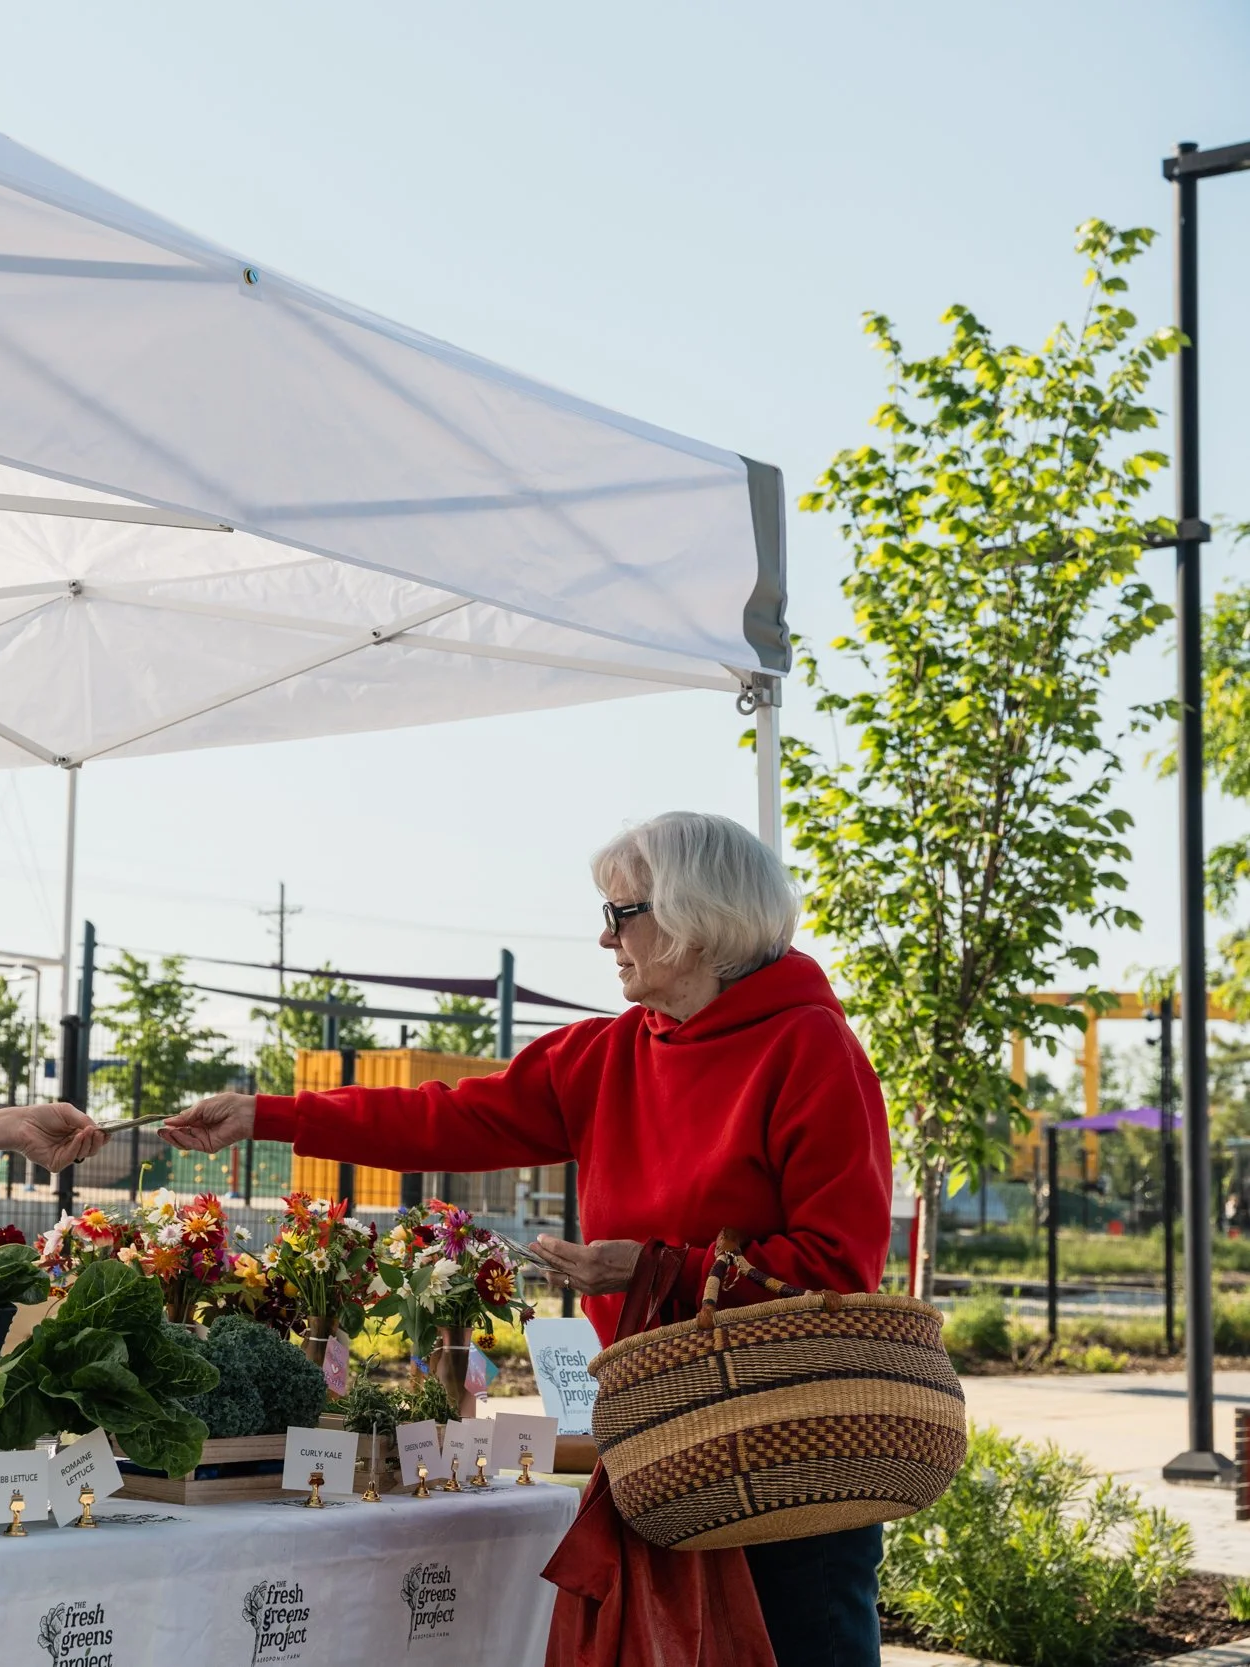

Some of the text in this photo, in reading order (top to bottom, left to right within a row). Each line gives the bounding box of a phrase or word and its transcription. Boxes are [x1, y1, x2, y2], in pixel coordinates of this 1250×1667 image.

[554, 1349, 588, 1366] fresh
[559, 1369, 597, 1387] green
[563, 1389, 598, 1406] projec
[404, 1440, 433, 1451] GREEN ONION
[473, 1437, 489, 1445] THYME
[518, 1432, 533, 1441] DILL
[300, 1448, 343, 1460] CURLY KALE
[60, 1451, 93, 1476] ROMAINE
[315, 1462, 324, 1470] $5
[10, 1473, 38, 1483] LETTUCE
[66, 1463, 95, 1487] LETTUCE
[421, 1565, 451, 1584] fresh
[276, 1580, 287, 1588] THE
[266, 1583, 304, 1605] fresh
[417, 1587, 457, 1610] greens
[74, 1601, 87, 1609] THE
[64, 1603, 104, 1628] fresh
[262, 1607, 310, 1632] greens
[414, 1606, 455, 1631] project
[60, 1629, 113, 1657] greens
[258, 1626, 307, 1654] project
